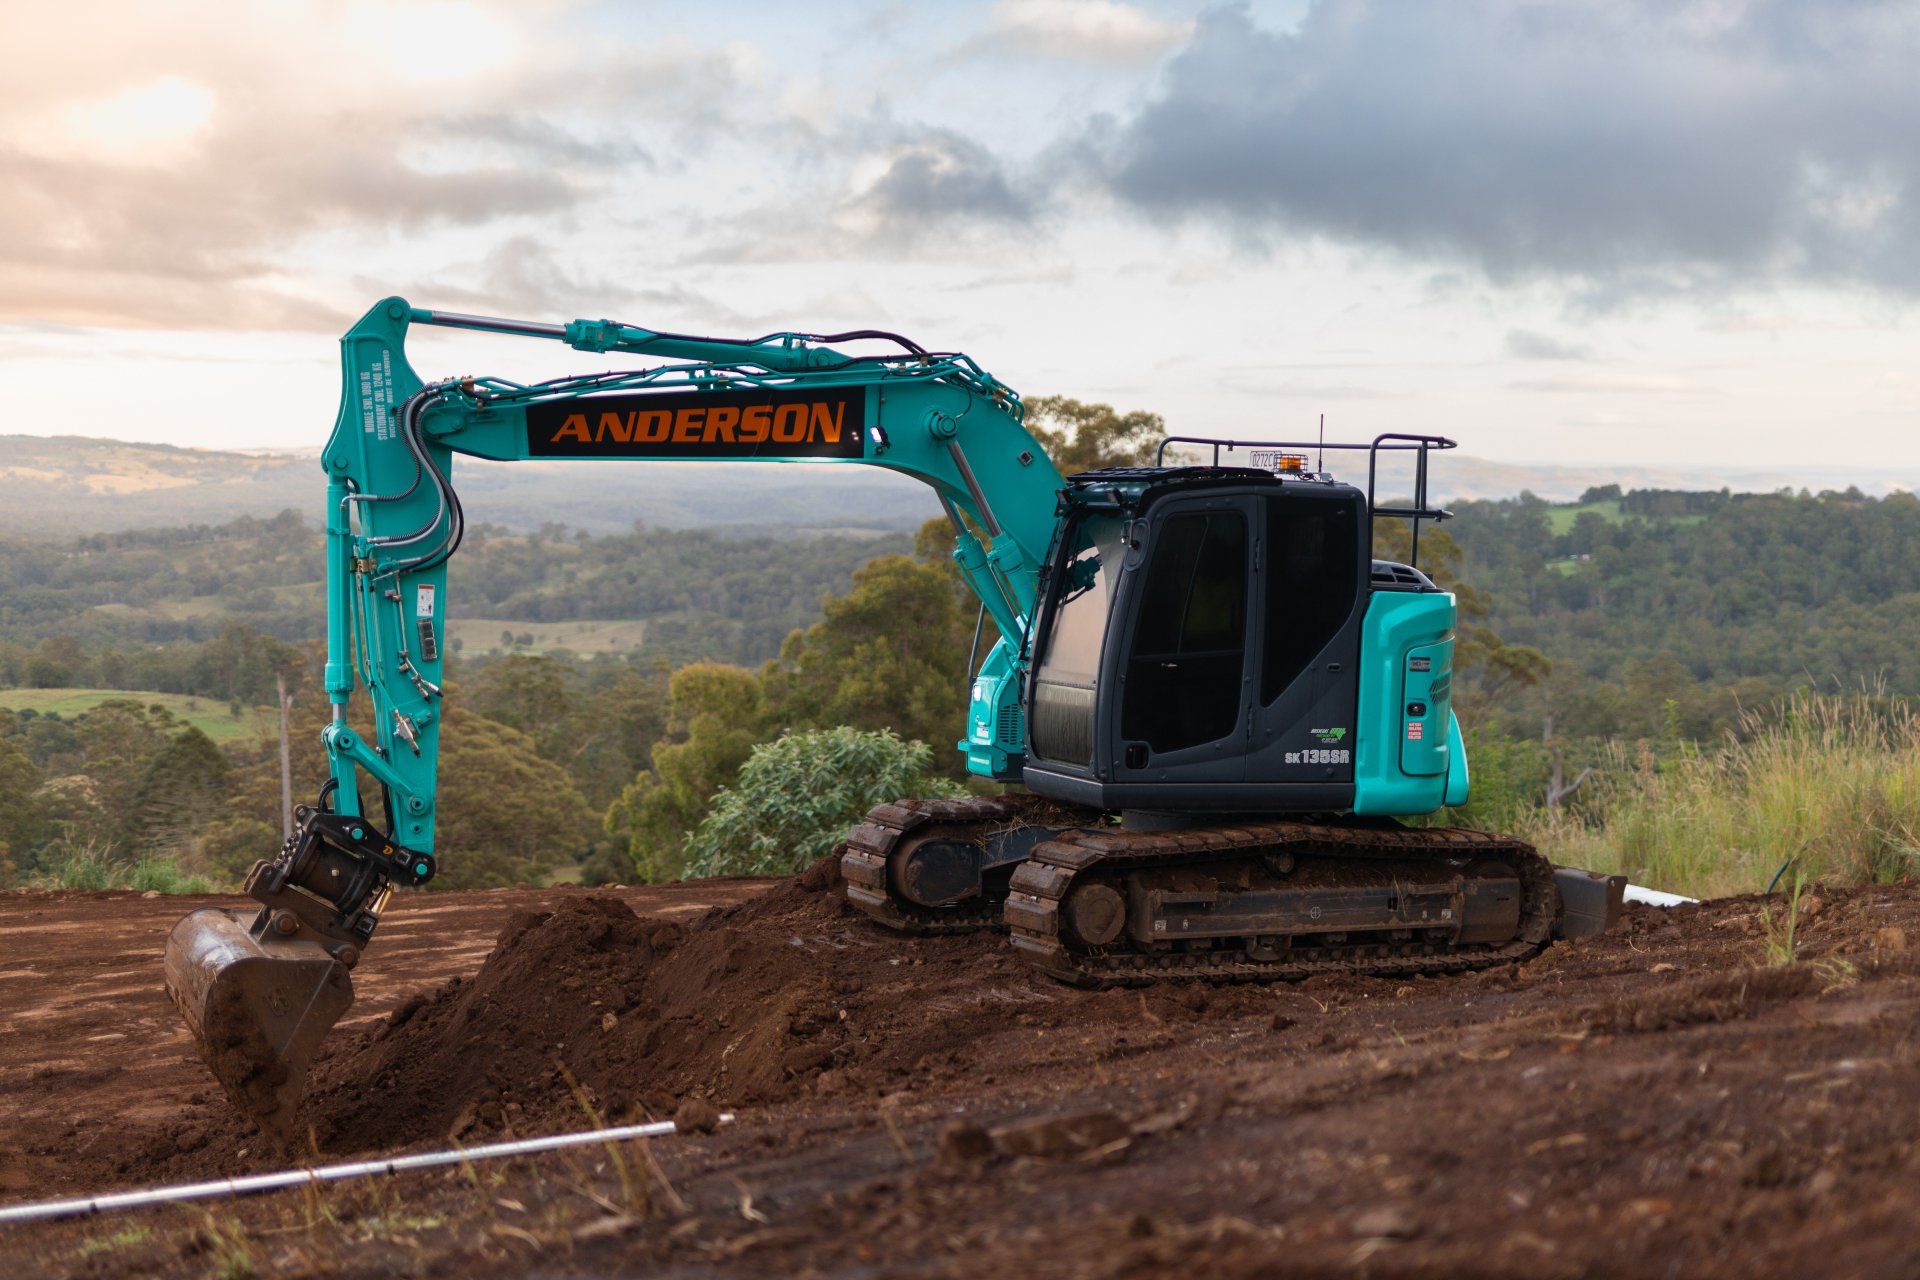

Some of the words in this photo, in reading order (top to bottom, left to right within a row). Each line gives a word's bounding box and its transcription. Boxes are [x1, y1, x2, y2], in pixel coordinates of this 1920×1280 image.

[372, 362, 381, 371] KG
[385, 378, 391, 386] BE
[374, 389, 384, 402] SWL
[363, 397, 373, 410] SWL
[376, 404, 388, 440] STATIONARY
[551, 401, 846, 443] ANDERSON
